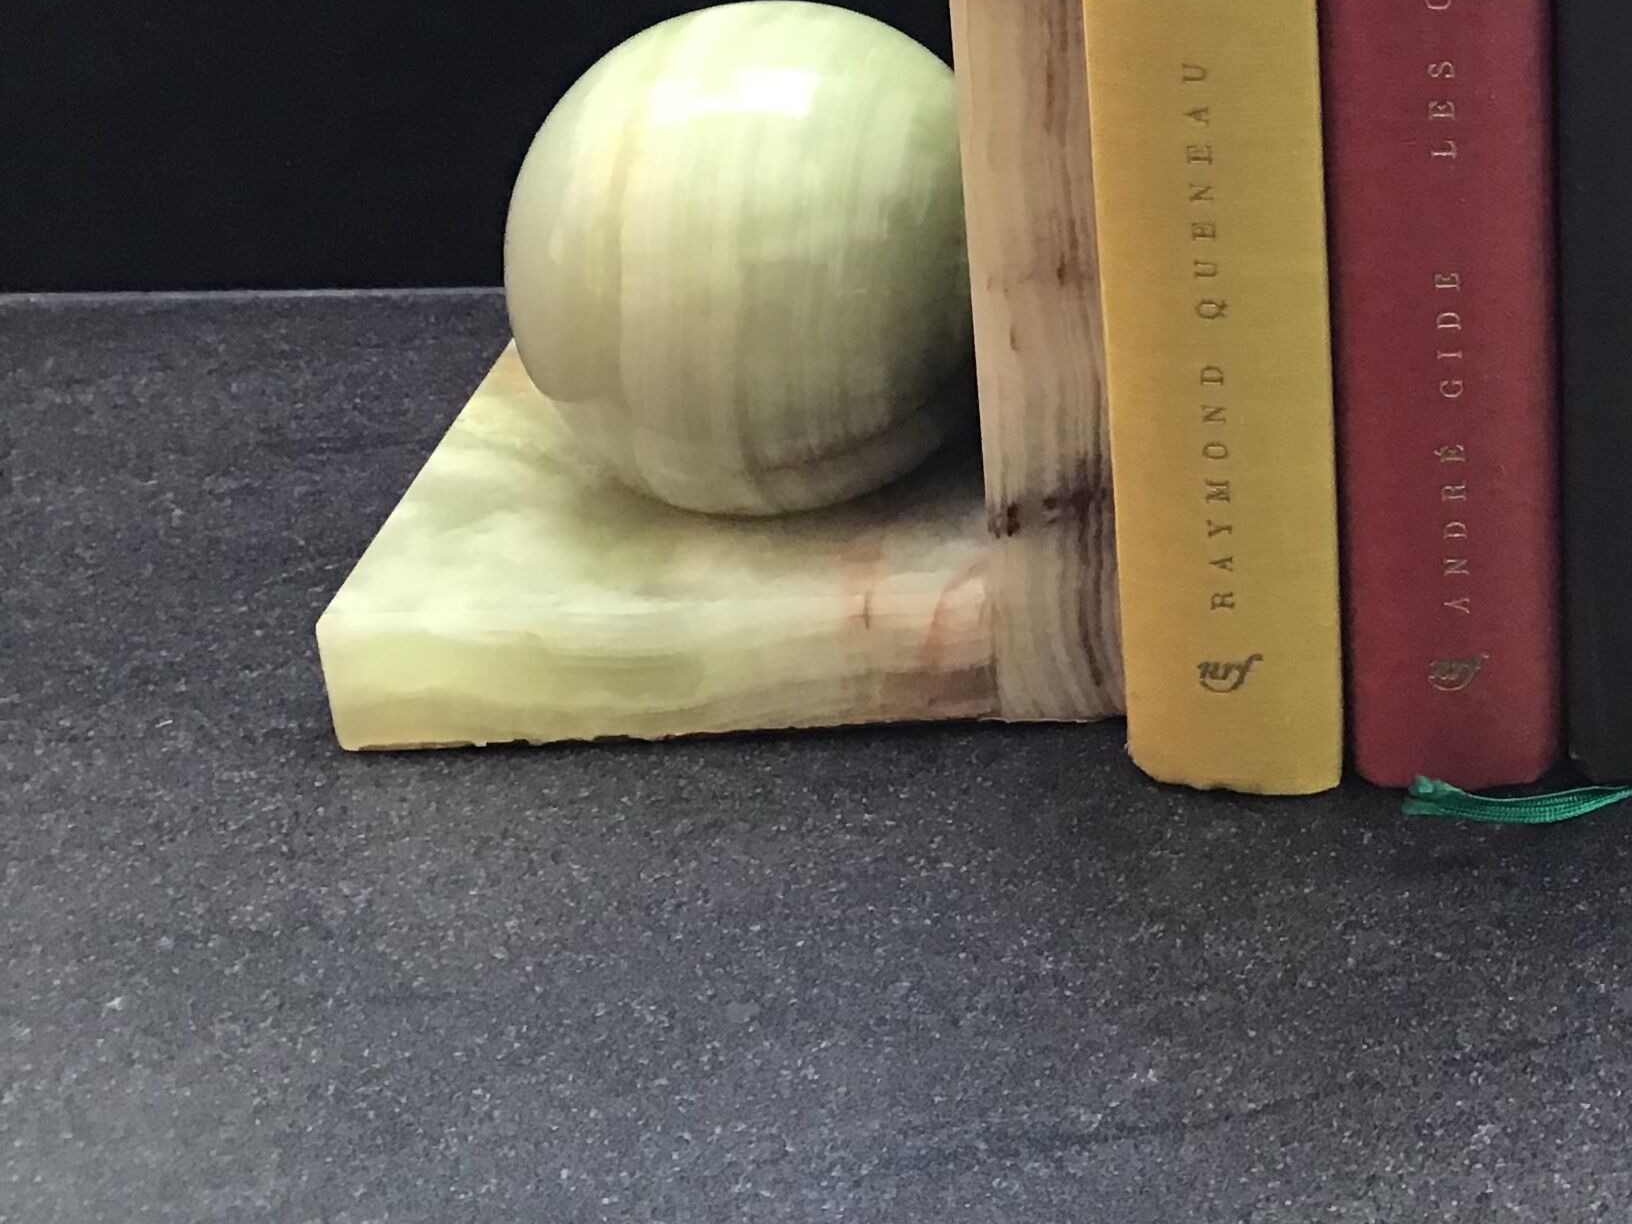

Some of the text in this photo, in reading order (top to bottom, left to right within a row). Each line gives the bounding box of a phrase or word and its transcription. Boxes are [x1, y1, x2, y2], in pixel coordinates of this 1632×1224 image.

[1181, 63, 1228, 320] QUENEAU
[1427, 60, 1458, 160] LES
[1434, 272, 1464, 399] GIDE
[1200, 364, 1236, 611] RAYMOND
[1433, 443, 1470, 614] ANDRÉ
